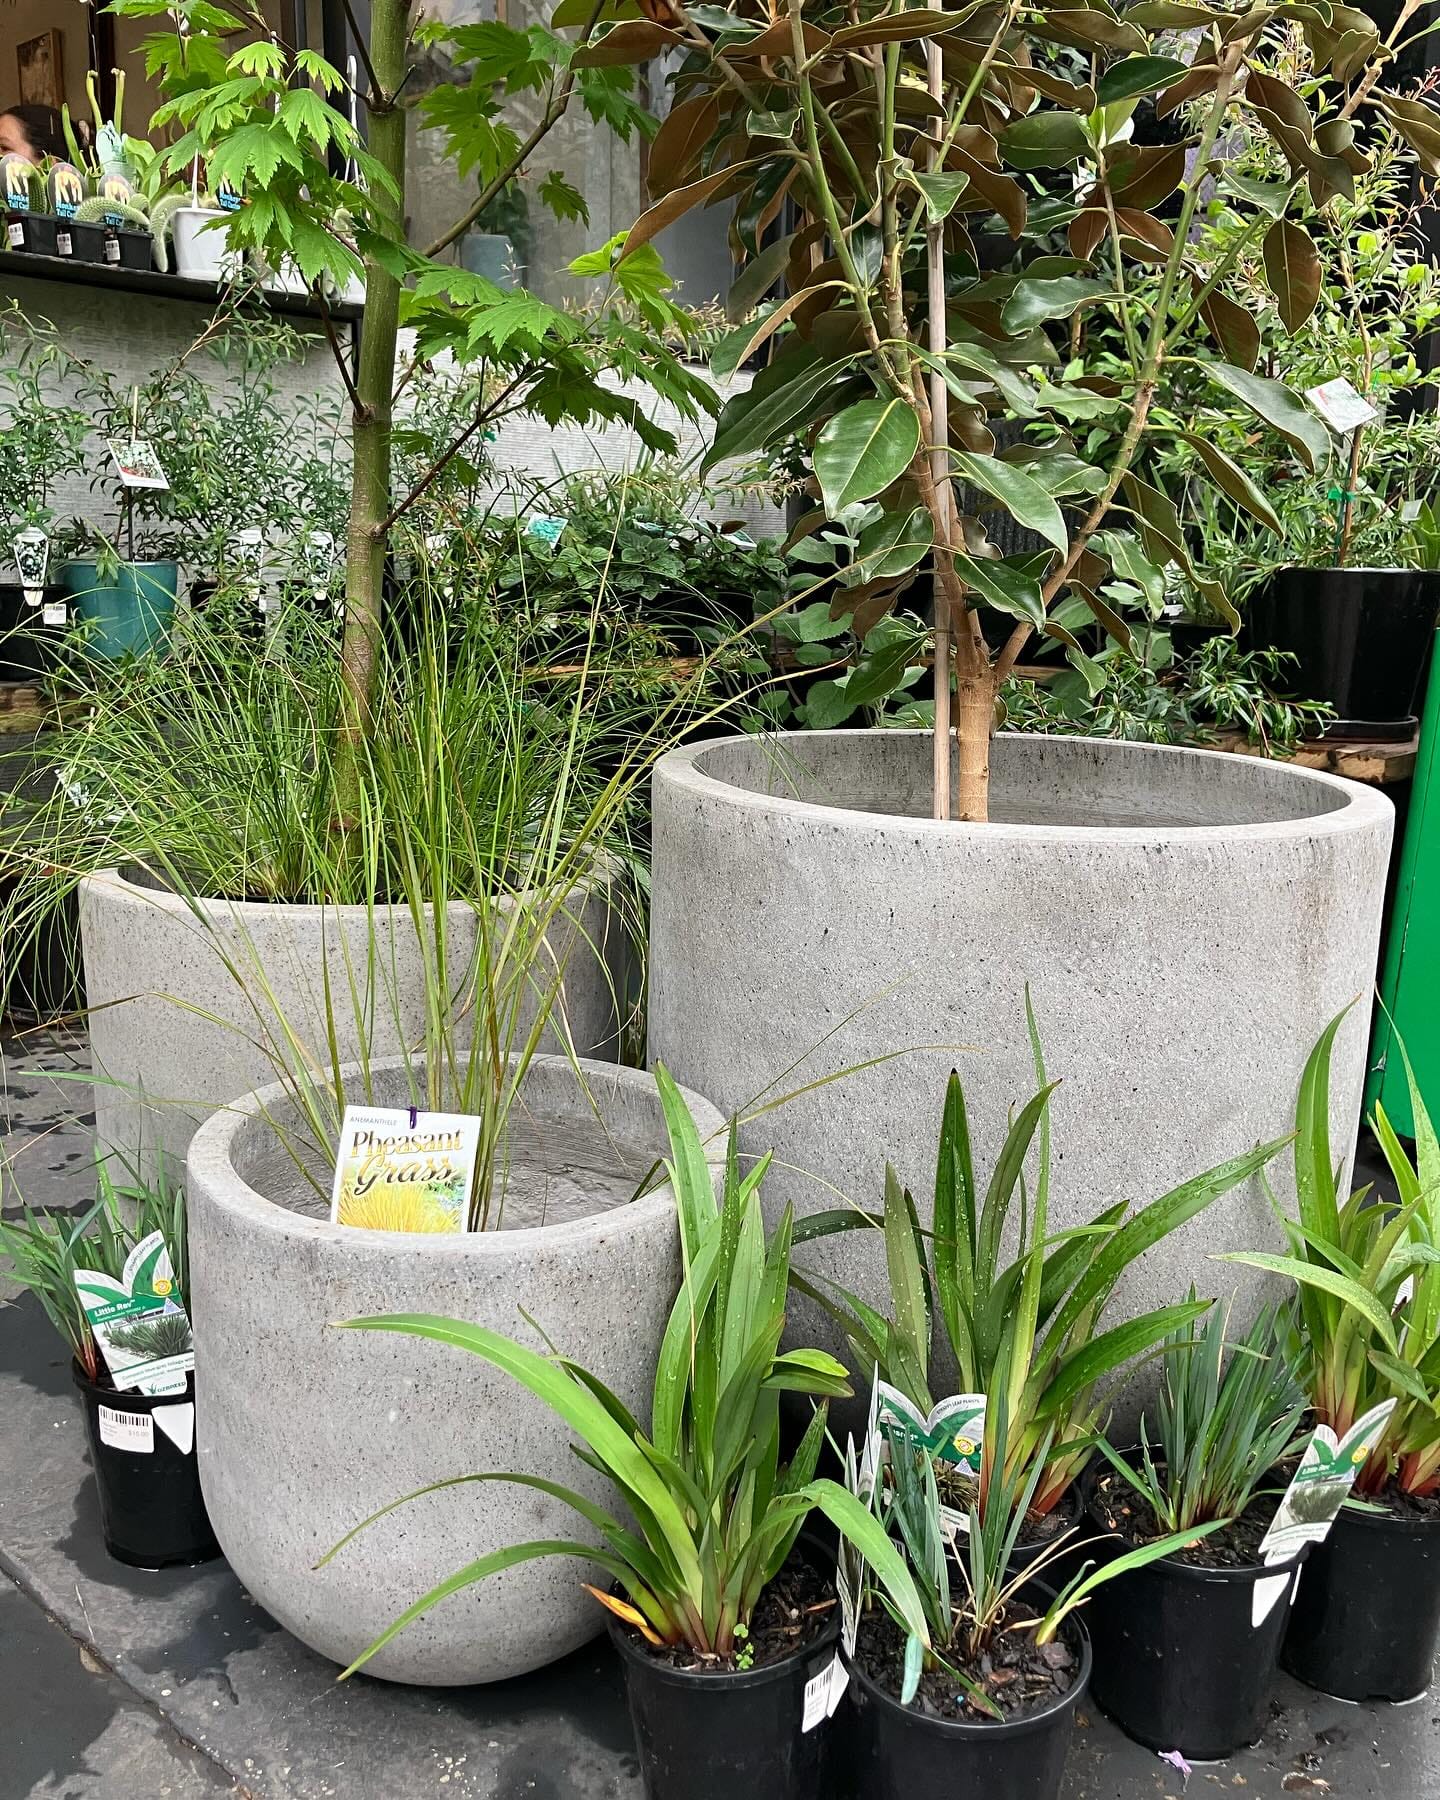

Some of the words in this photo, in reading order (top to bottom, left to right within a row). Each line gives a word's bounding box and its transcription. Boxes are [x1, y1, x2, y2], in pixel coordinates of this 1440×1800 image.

[349, 1115, 398, 1127] ANEMANTHELE
[350, 1128, 464, 1159] Pheasant
[353, 1154, 457, 1196] Grass
[94, 1305, 116, 1317] Little
